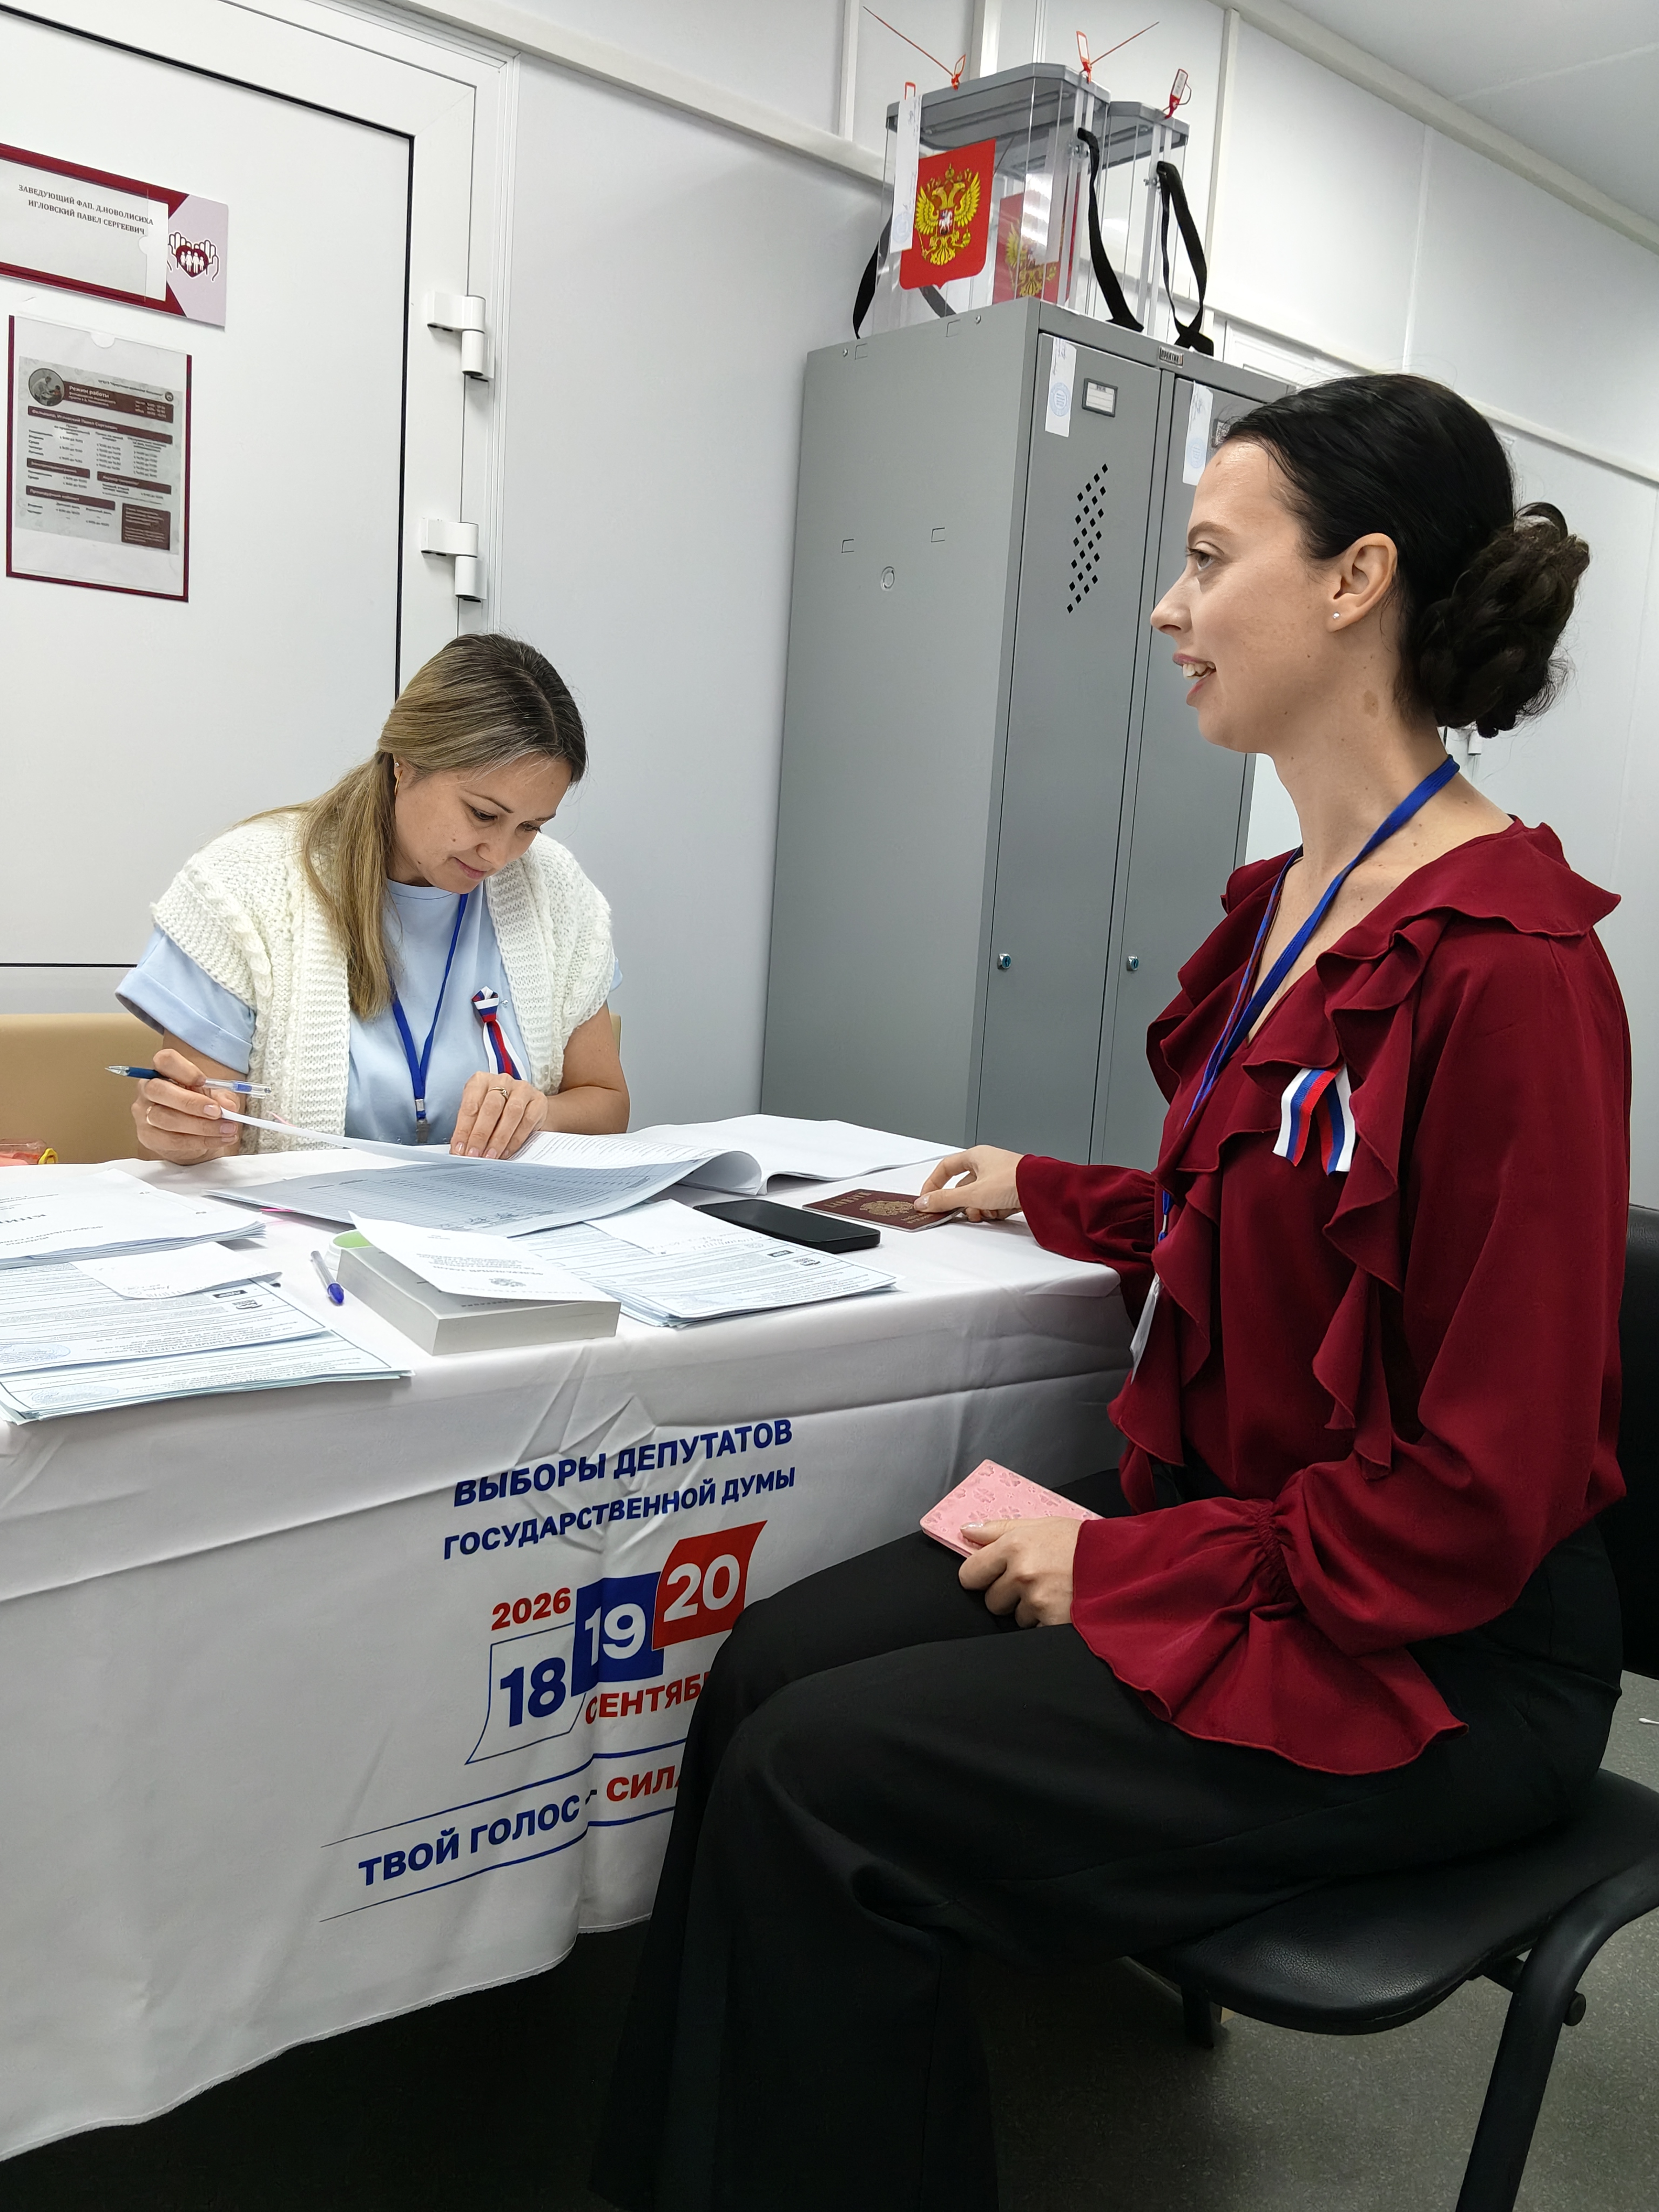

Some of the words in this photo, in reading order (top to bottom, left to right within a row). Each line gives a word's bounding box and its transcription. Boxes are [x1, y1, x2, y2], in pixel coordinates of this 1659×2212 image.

[18, 184, 75, 205] ЗАВЕДУЮЩИЙ
[76, 199, 95, 210] ФАП.
[28, 199, 75, 218] ИГЛОВСКИЙ
[77, 212, 102, 224] ПАВЕЛ
[103, 219, 145, 235] СЕРГЕЕВИЧ
[454, 1453, 606, 1507] ВЫБОРЫ
[613, 1419, 793, 1480] ДЕПУТАТОВ
[444, 1478, 716, 1560] ГОСУДАРСТВЕННОЙ
[721, 1467, 795, 1505] ДУМЫ
[491, 1587, 571, 1631] 2026
[500, 1657, 566, 1728] 18
[584, 1603, 646, 1667] 19
[663, 1554, 740, 1623] 20
[585, 1671, 711, 1724] СЕНТЯБ
[358, 1827, 460, 1886] ТВОЙ
[470, 1795, 581, 1854] ГОЛОС
[606, 1765, 680, 1802] СИЛ
